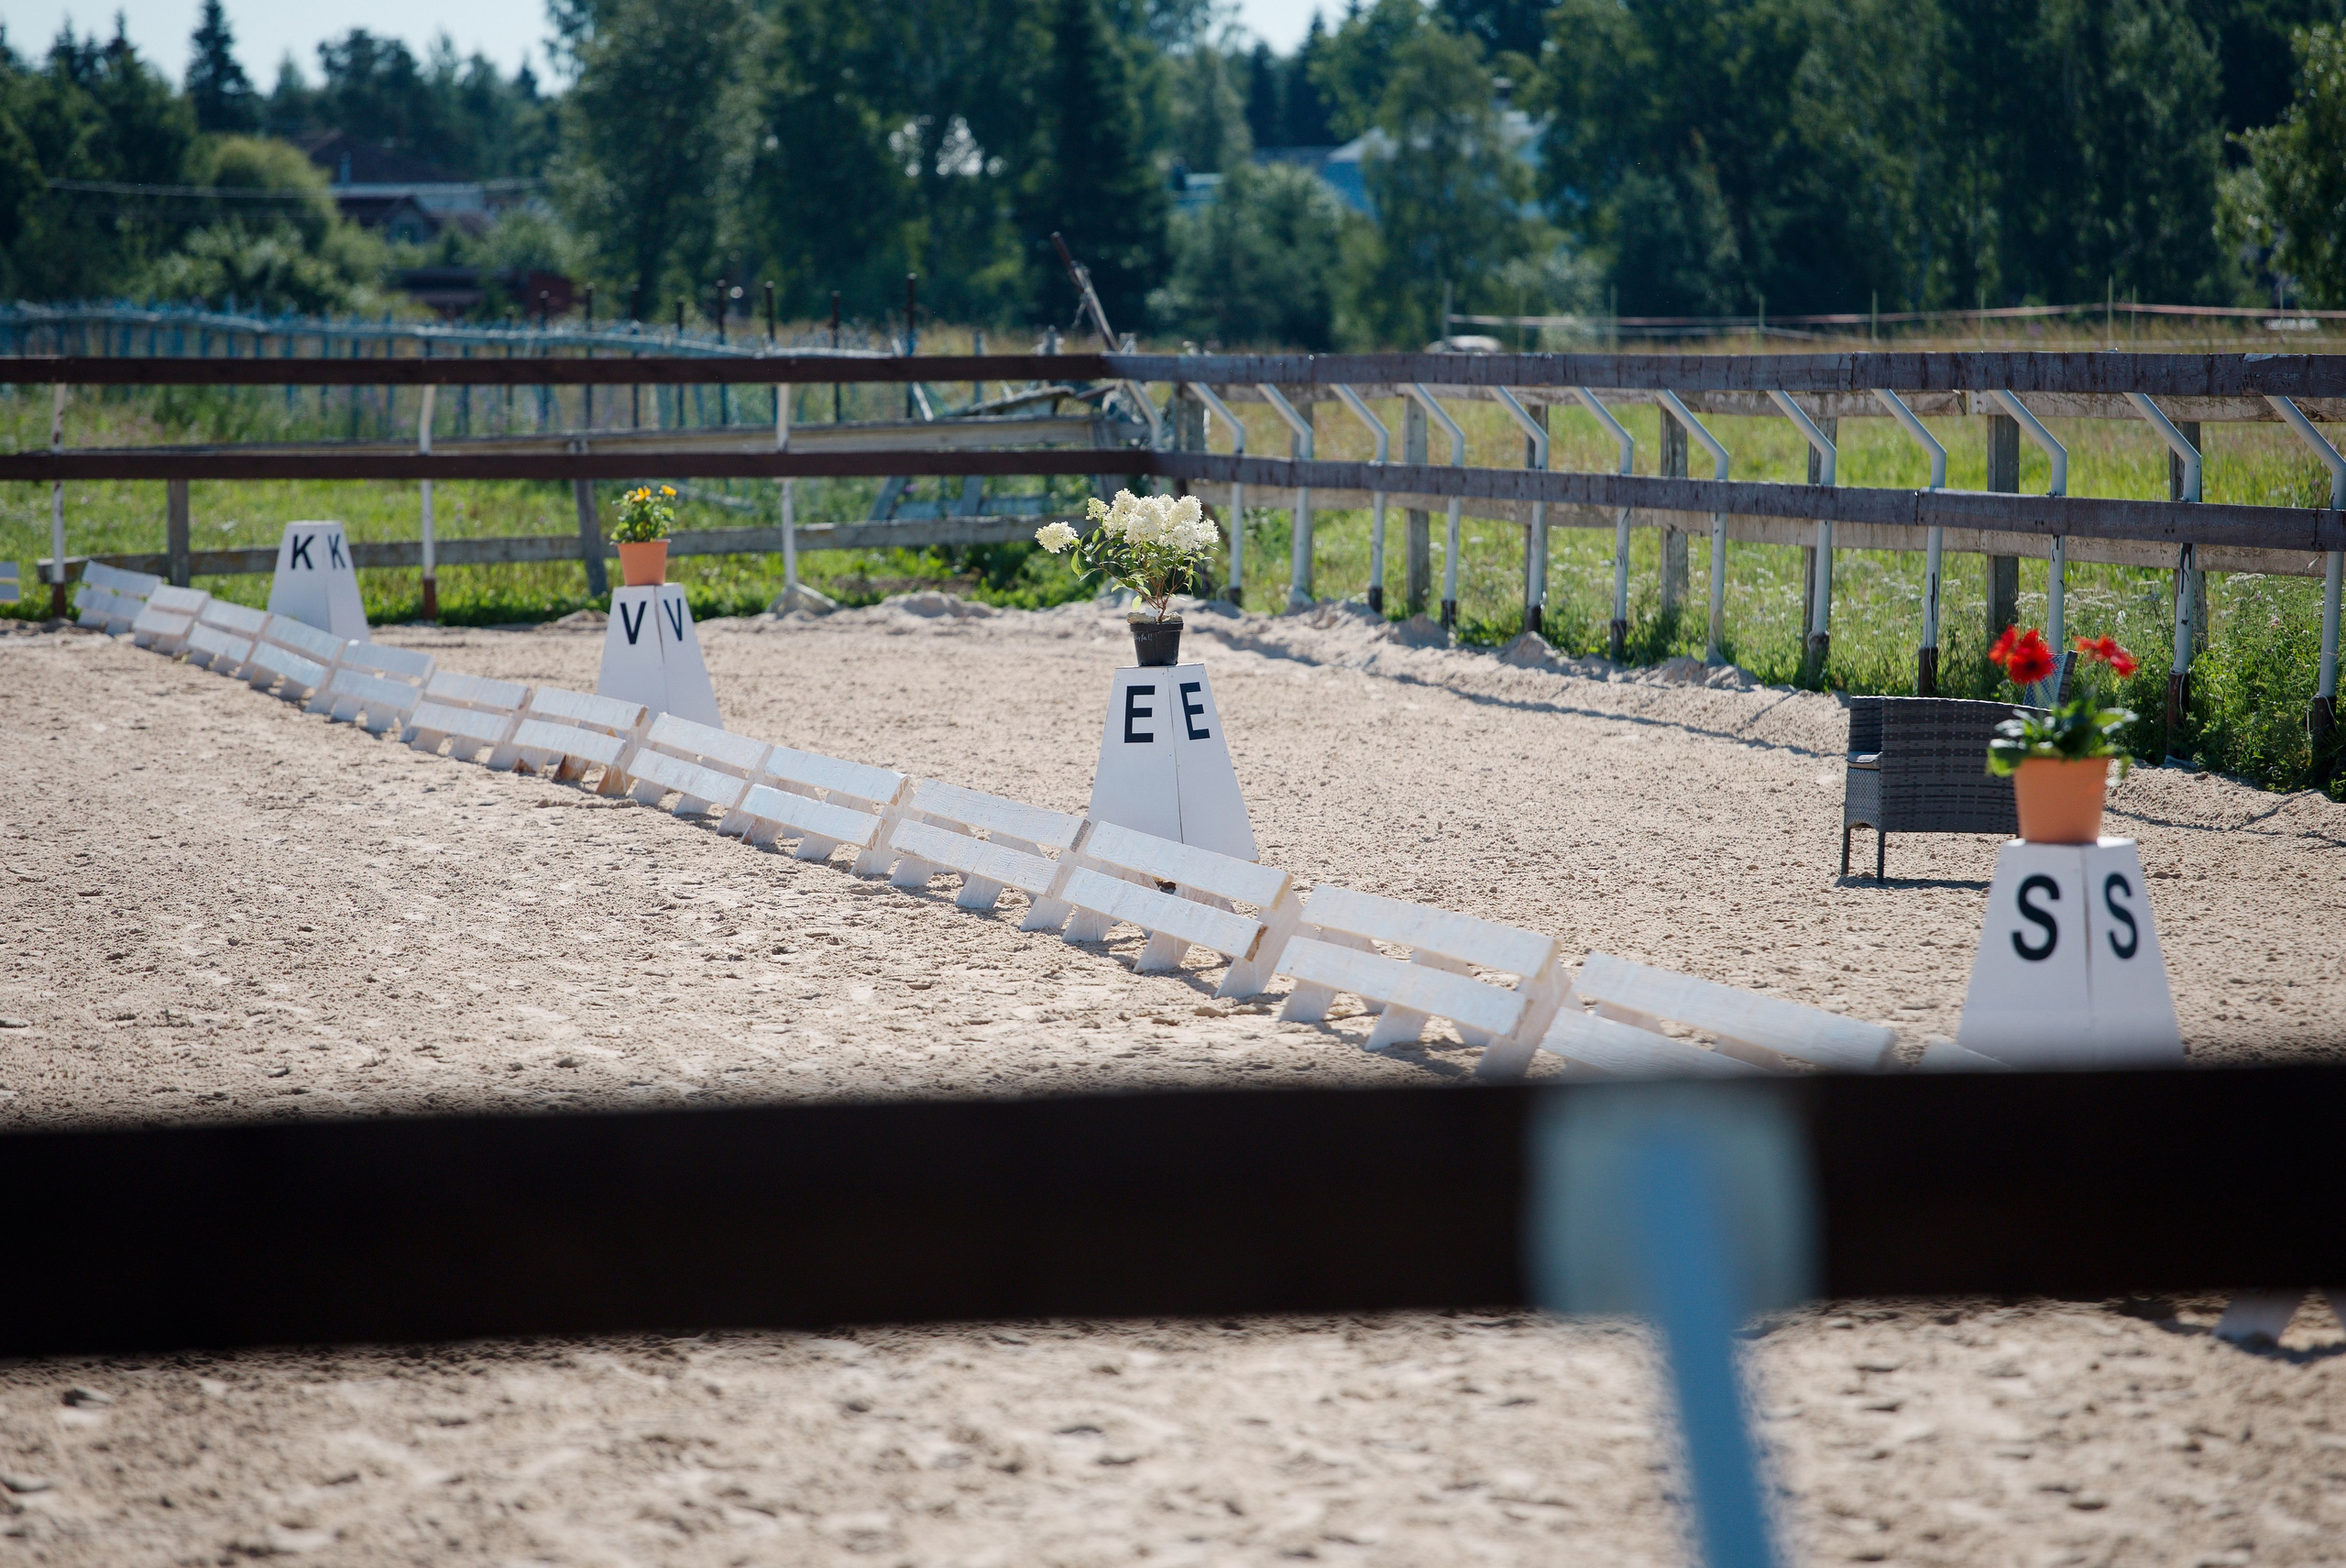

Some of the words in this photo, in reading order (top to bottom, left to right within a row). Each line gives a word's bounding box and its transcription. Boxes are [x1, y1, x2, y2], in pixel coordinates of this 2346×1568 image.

[291, 534, 315, 570] K
[327, 534, 346, 569] K
[619, 601, 647, 645] V
[663, 598, 684, 642] V
[1124, 685, 1157, 744] E
[1178, 681, 1211, 741] E
[2011, 872, 2062, 963] S
[2102, 871, 2140, 961] S
